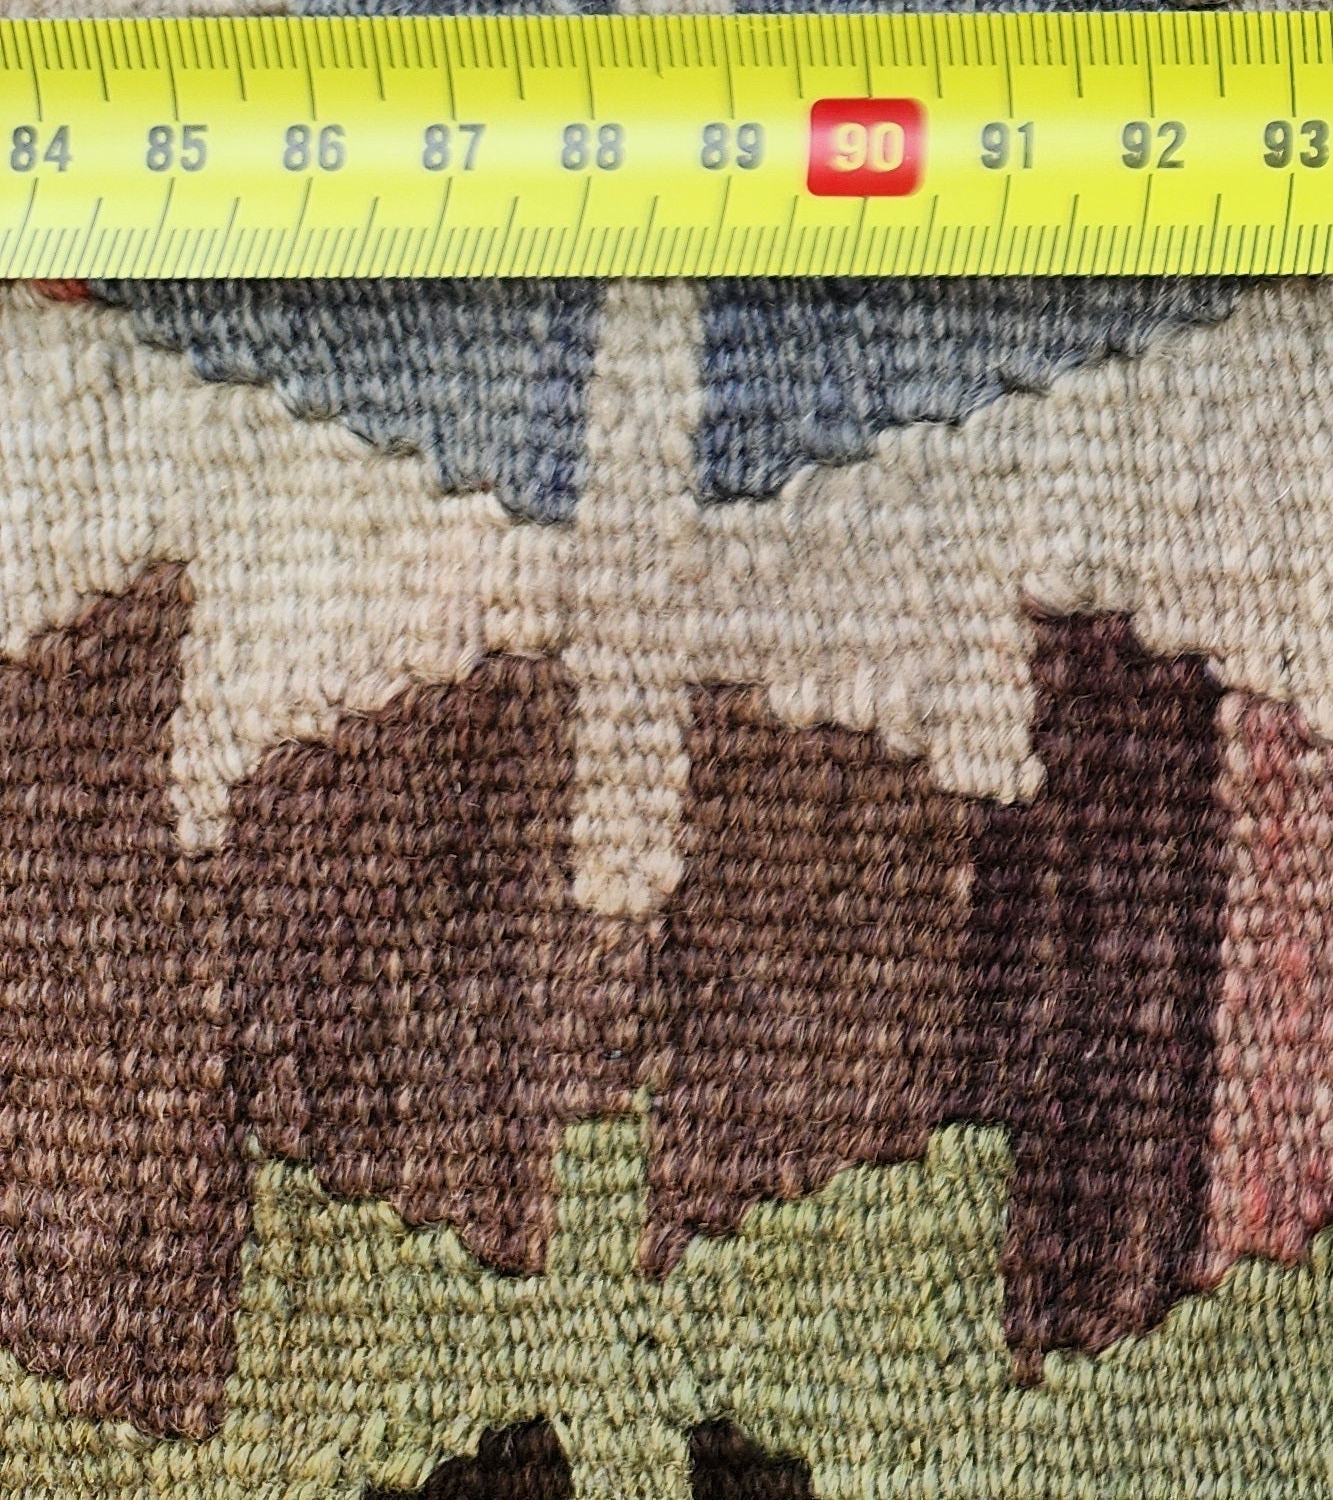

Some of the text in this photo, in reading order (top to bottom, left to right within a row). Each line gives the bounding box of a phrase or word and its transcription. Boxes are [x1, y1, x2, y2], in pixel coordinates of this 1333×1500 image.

[10, 125, 72, 175] 84
[146, 124, 208, 174] 85
[283, 124, 345, 174] 86
[422, 124, 486, 174] 87
[561, 123, 623, 173] 88
[701, 123, 763, 173] 89
[833, 121, 904, 172] 90
[980, 122, 1034, 172] 91
[1121, 121, 1186, 171] 92
[1263, 120, 1329, 170] 93
